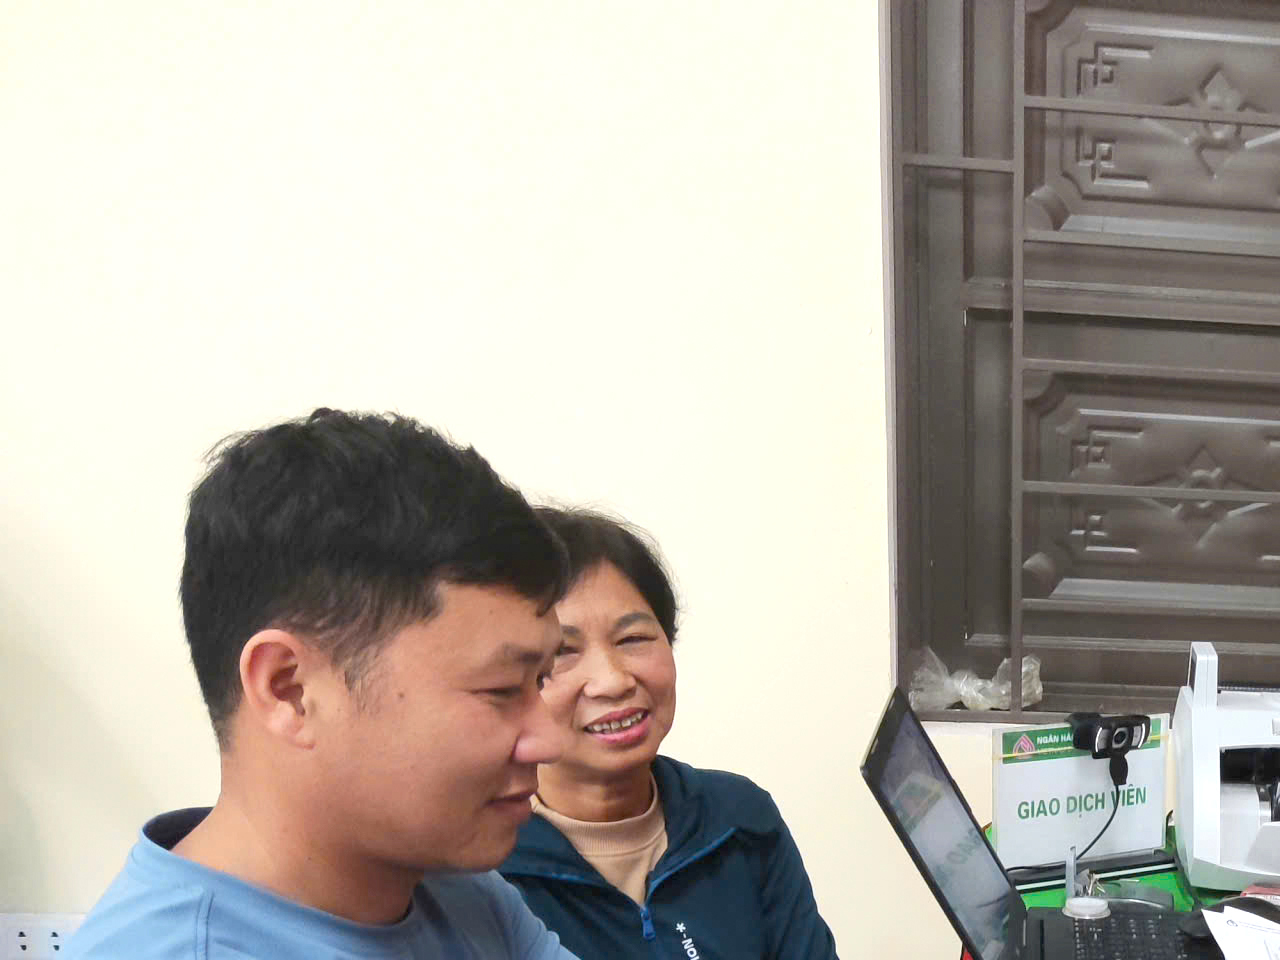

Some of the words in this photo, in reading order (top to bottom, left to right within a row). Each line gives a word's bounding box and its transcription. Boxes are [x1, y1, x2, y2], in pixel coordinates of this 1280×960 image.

[1037, 734, 1059, 744] NGÂN
[1018, 798, 1060, 819] GIAO
[1066, 792, 1105, 818] DỊCH
[1110, 784, 1147, 807] VIÊN
